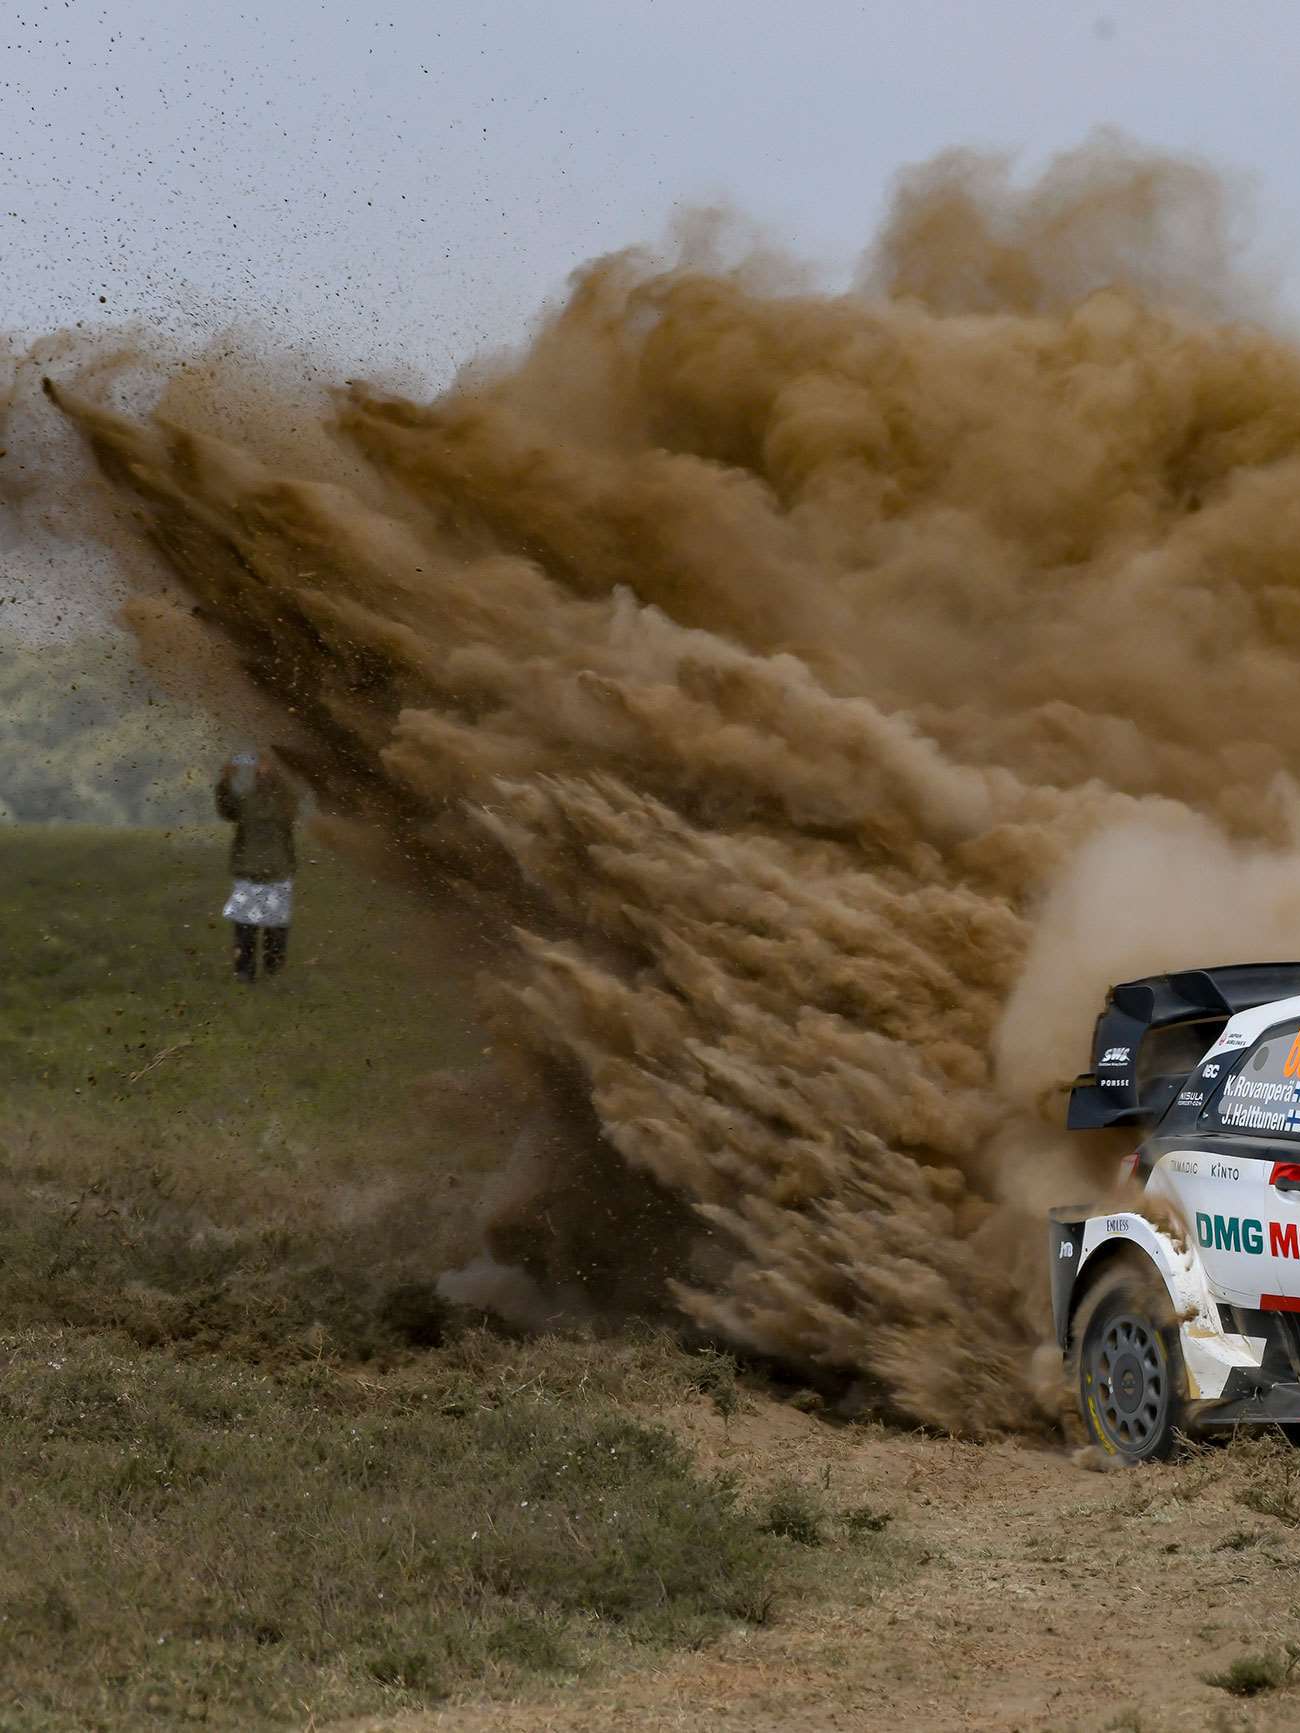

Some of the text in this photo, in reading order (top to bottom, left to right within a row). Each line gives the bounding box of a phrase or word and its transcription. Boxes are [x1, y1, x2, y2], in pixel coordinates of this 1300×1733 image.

[1223, 1074, 1295, 1105] K.Rovanperä
[1221, 1102, 1286, 1131] J.Halttunen
[1195, 1211, 1264, 1255] DMG
